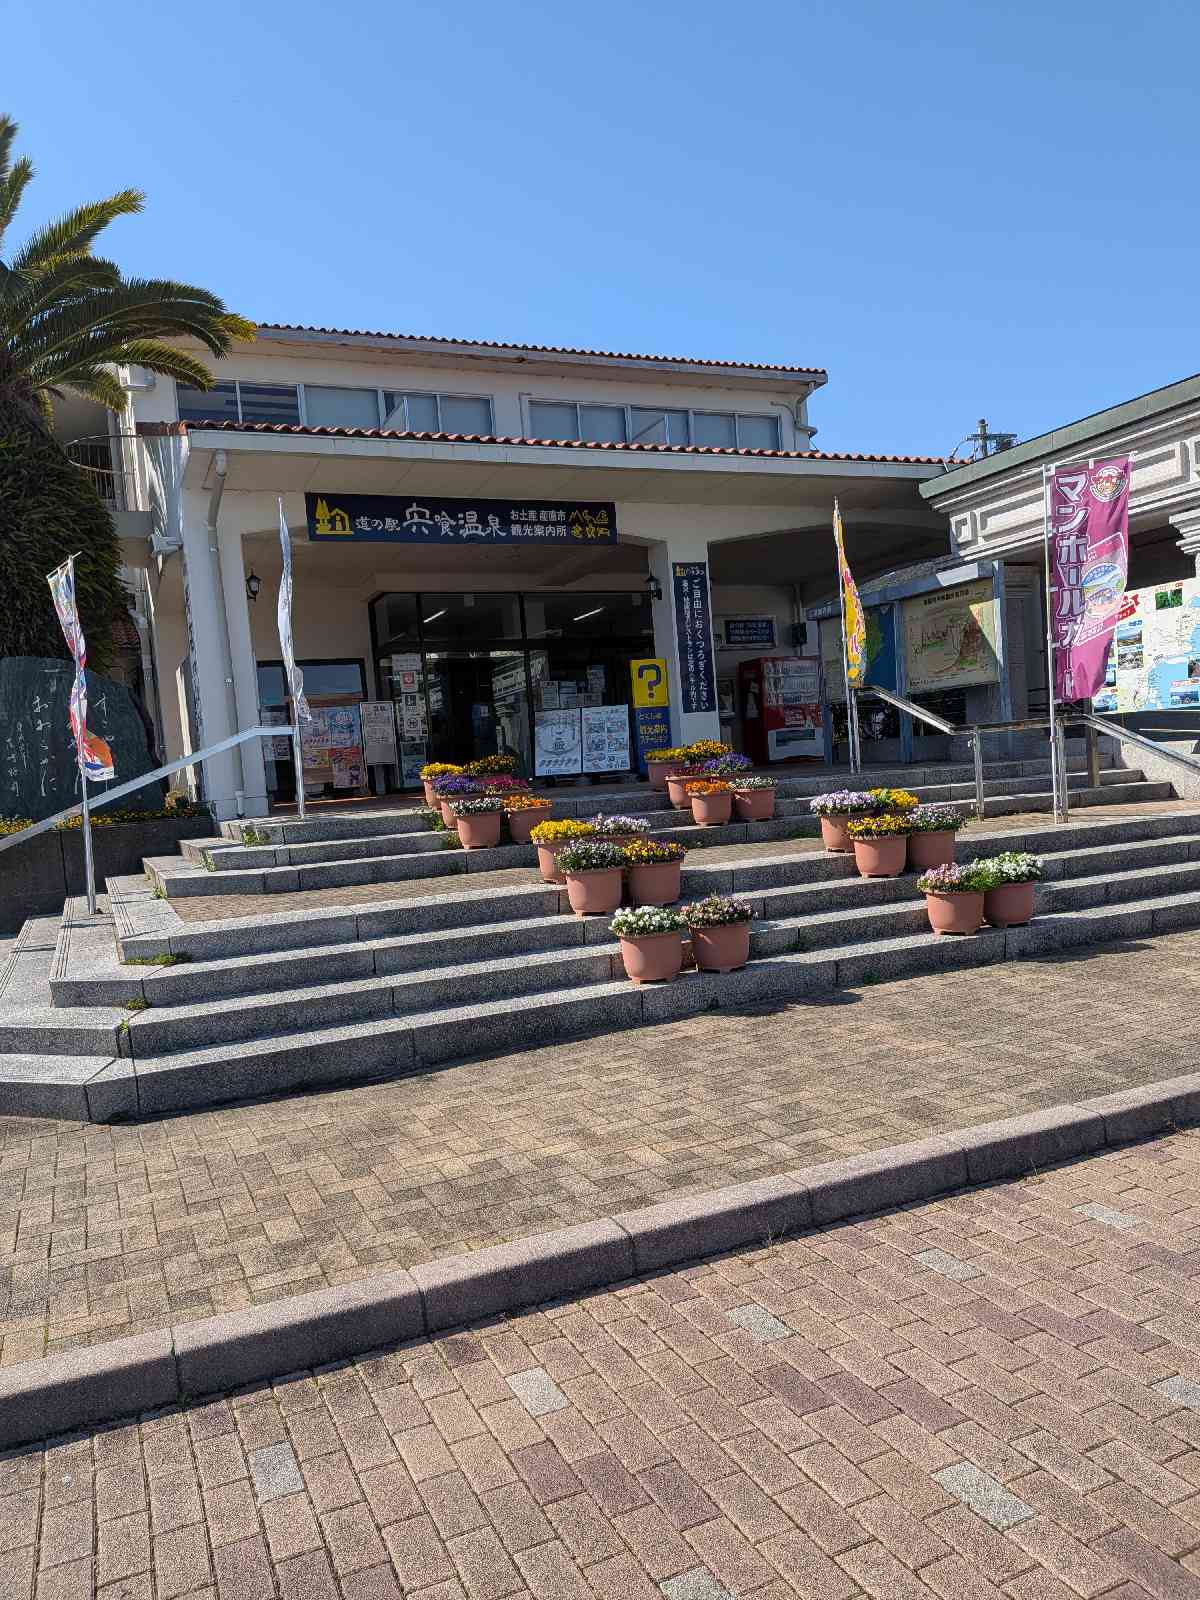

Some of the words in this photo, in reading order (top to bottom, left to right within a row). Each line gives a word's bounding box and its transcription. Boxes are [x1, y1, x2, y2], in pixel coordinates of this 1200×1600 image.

[402, 502, 507, 538] 宍喰温泉
[510, 524, 567, 537] 観光案内所
[1056, 472, 1089, 700] マンホールカ
